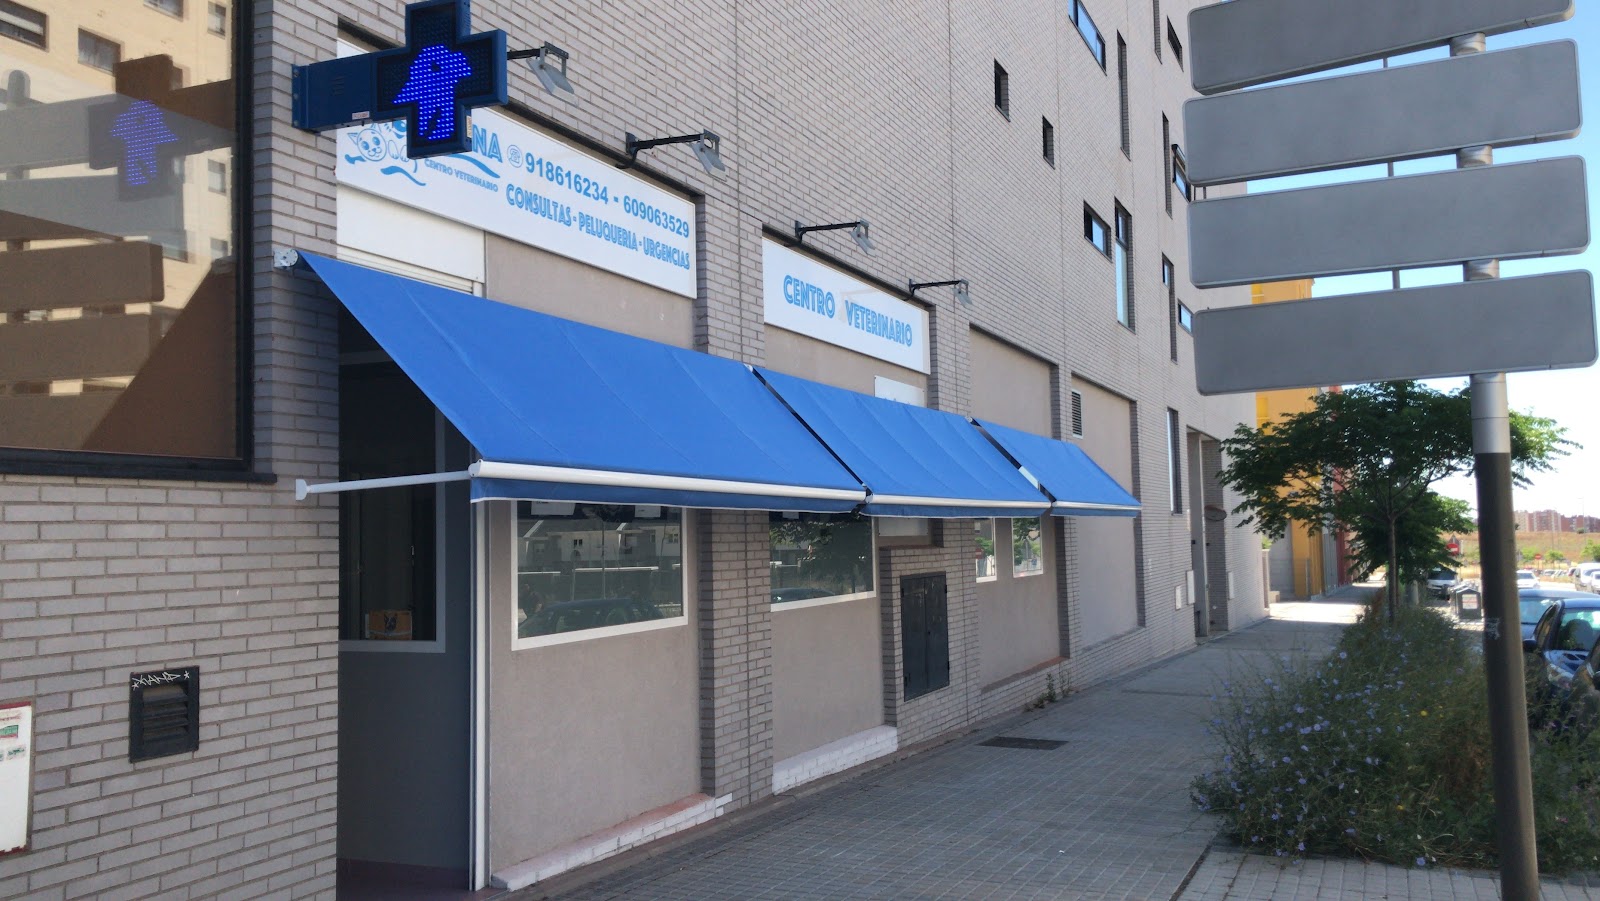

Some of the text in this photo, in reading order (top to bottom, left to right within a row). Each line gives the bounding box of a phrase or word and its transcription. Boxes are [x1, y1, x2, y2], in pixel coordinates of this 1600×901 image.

[424, 158, 498, 192] CENTRO VETERINARIO
[525, 152, 608, 204] 918616234
[623, 195, 690, 238] 609063529
[506, 183, 571, 227] CONSULTAS
[578, 212, 638, 251] PELUQUERIA
[643, 236, 690, 270] URGENCIAS
[783, 274, 912, 347] CENTRO VETERINARIO
